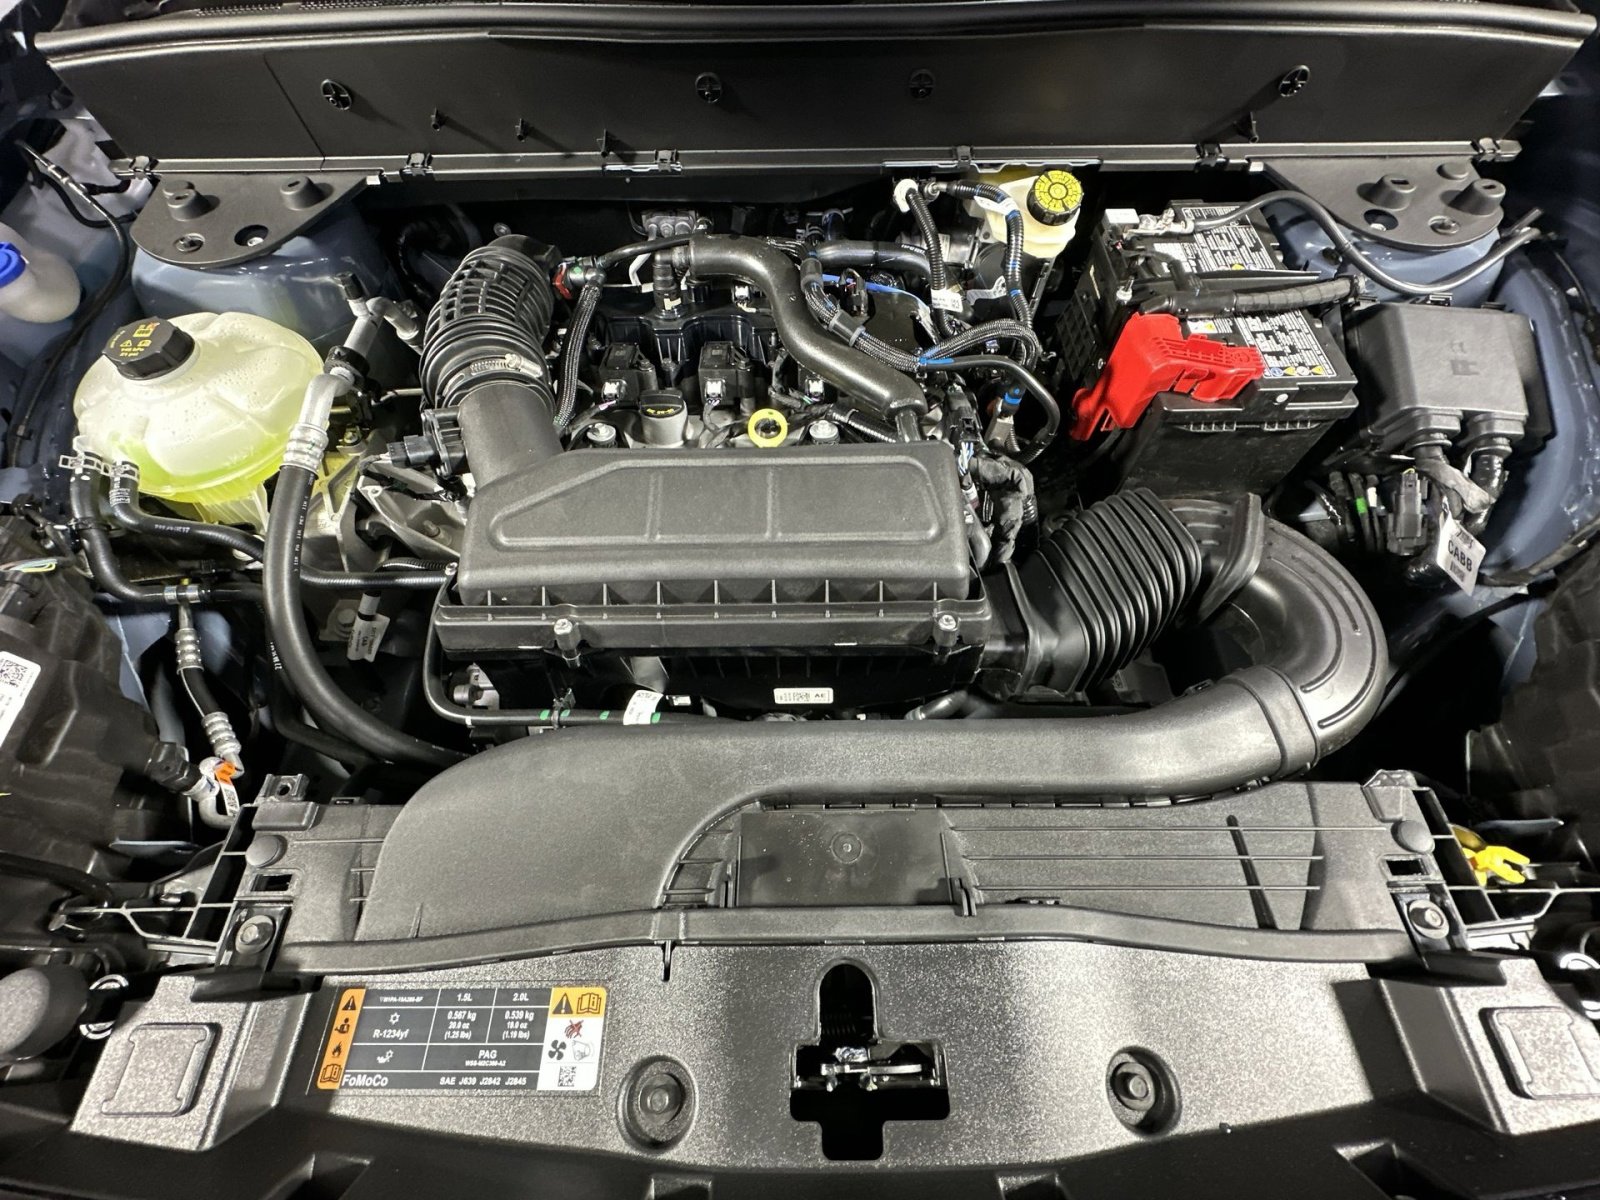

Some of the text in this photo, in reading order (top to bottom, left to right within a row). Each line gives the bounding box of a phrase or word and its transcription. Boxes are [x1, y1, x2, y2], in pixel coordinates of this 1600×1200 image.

[456, 992, 473, 1002] 1.5L
[512, 992, 530, 1002] 2.0L
[447, 1010, 477, 1022] 0.567 kg
[504, 1010, 535, 1022] 0.539 kg
[372, 1028, 410, 1039] R-1234yf
[478, 1049, 498, 1059] PAG
[341, 1074, 389, 1087] FoMoCo
[439, 1076, 527, 1086] SAE J639 J2842 J2845
